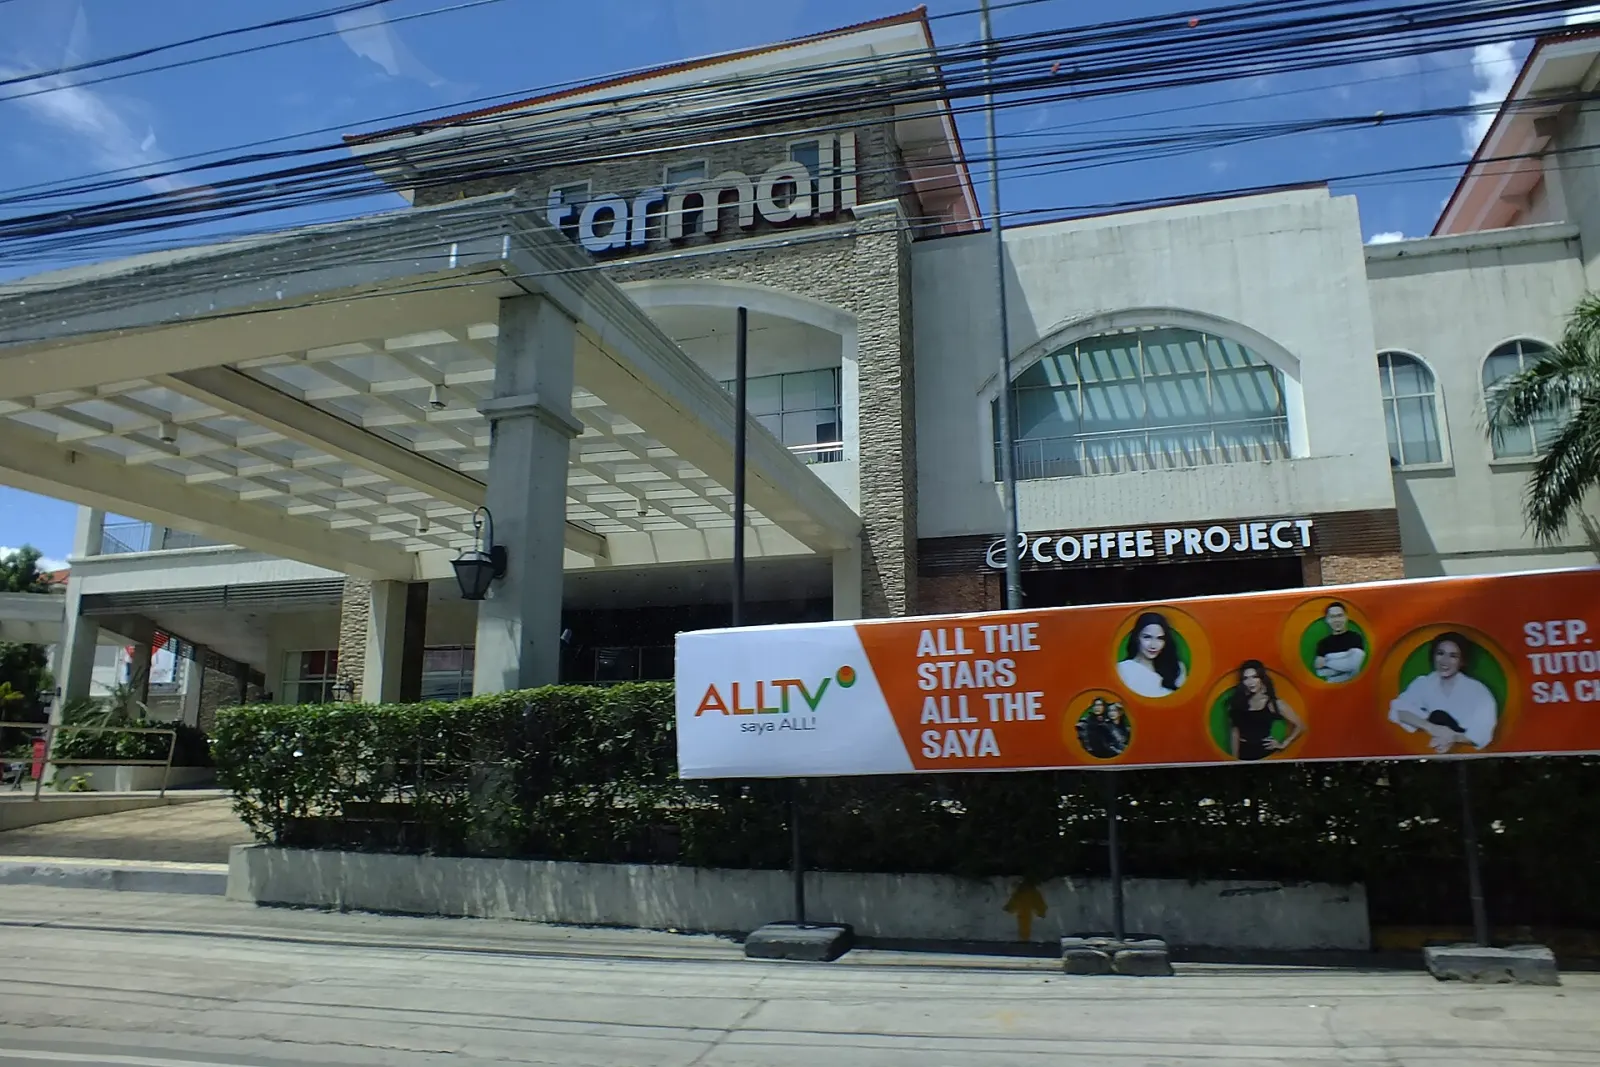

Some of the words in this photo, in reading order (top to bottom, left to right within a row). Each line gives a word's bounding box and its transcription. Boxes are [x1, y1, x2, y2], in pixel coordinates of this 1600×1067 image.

[1031, 530, 1155, 563] COFFEE
[1163, 519, 1314, 556] PROJECT
[916, 627, 975, 658] ALL
[979, 622, 1041, 653] THE
[1523, 619, 1593, 647] SEP.
[917, 658, 1017, 691] STARS
[694, 677, 832, 717] ALLTV
[920, 694, 979, 725] ALL
[983, 691, 1046, 722] THE
[1531, 680, 1570, 703] SA
[740, 721, 775, 736] saya
[778, 716, 816, 731] ALL!
[921, 728, 1001, 759] SAYA
